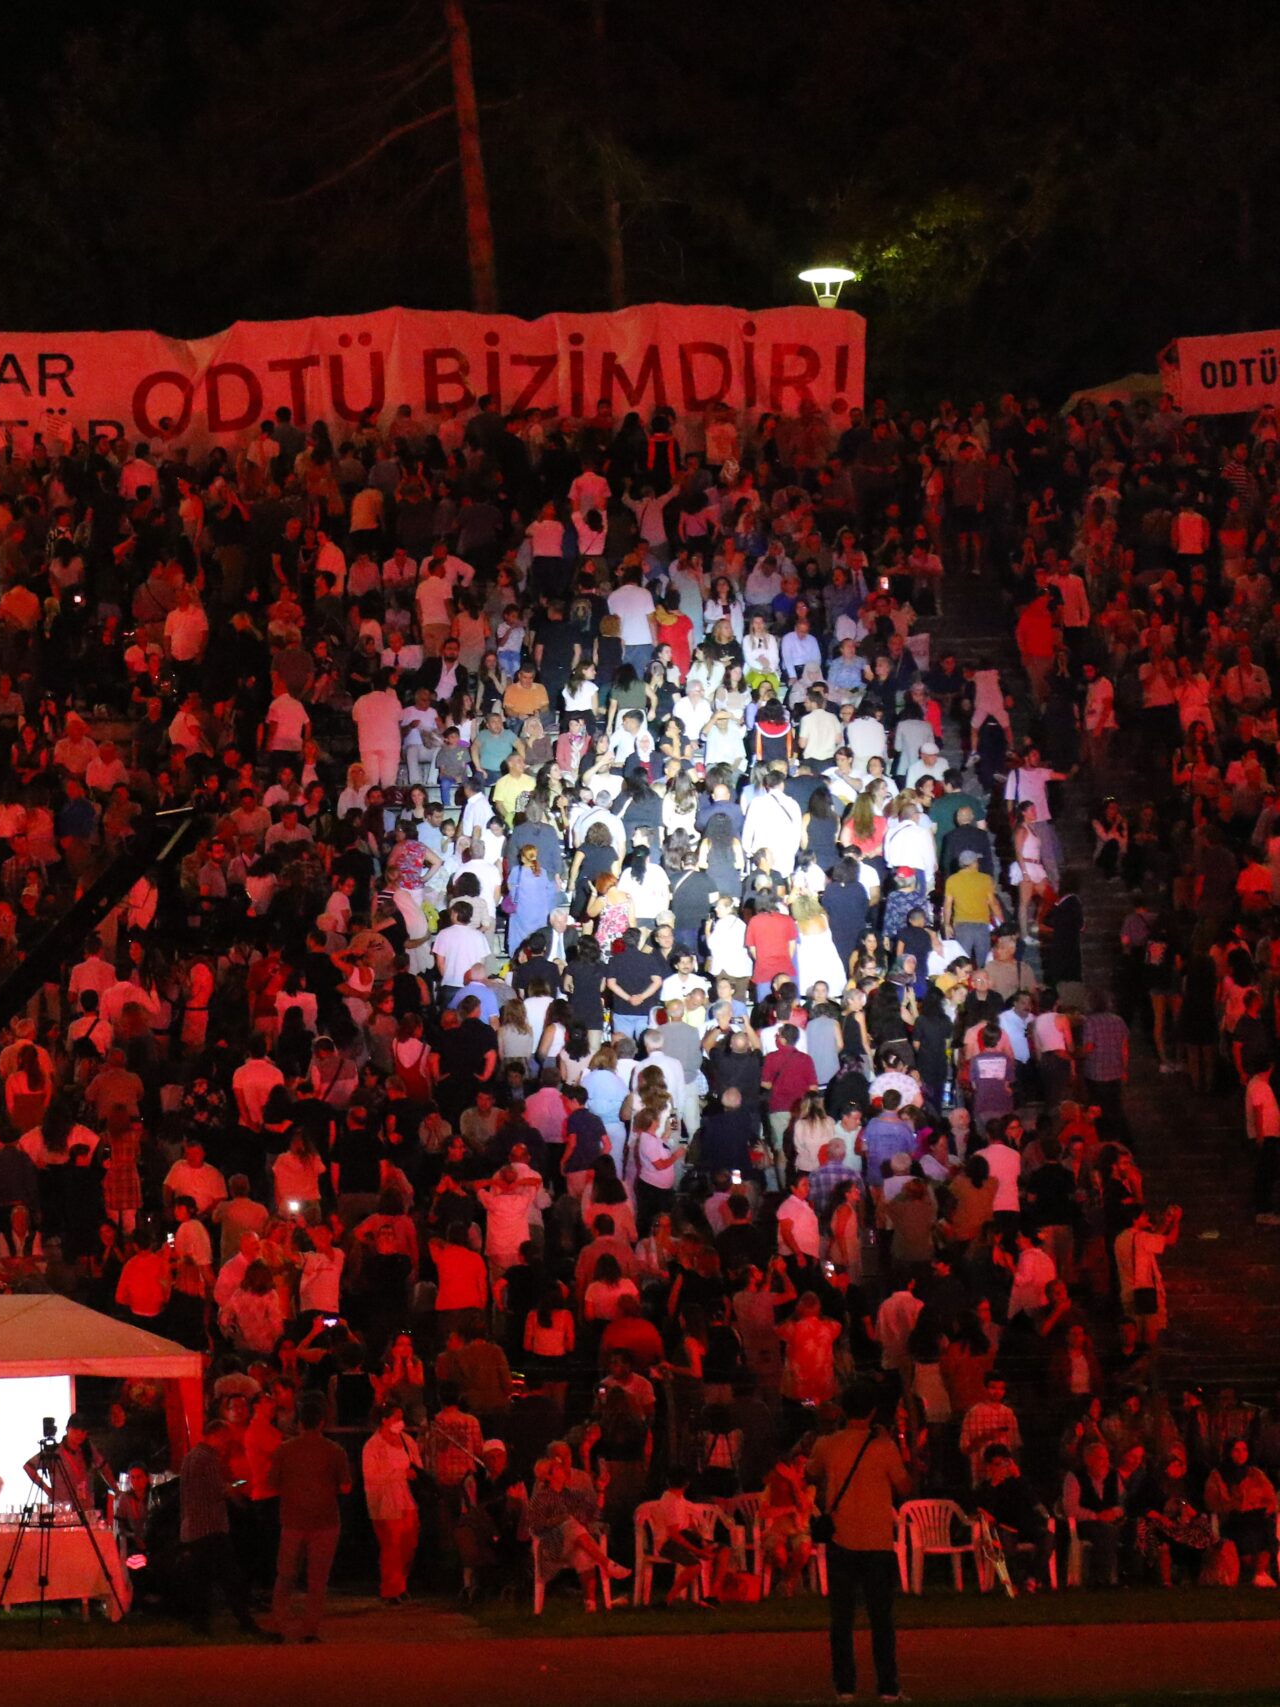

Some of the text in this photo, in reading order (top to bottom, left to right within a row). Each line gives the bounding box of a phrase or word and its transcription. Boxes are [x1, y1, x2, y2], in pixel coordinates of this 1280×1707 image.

[131, 320, 849, 440] ODTÜ BİZİMDİR!
[1200, 347, 1278, 390] ODTÜ
